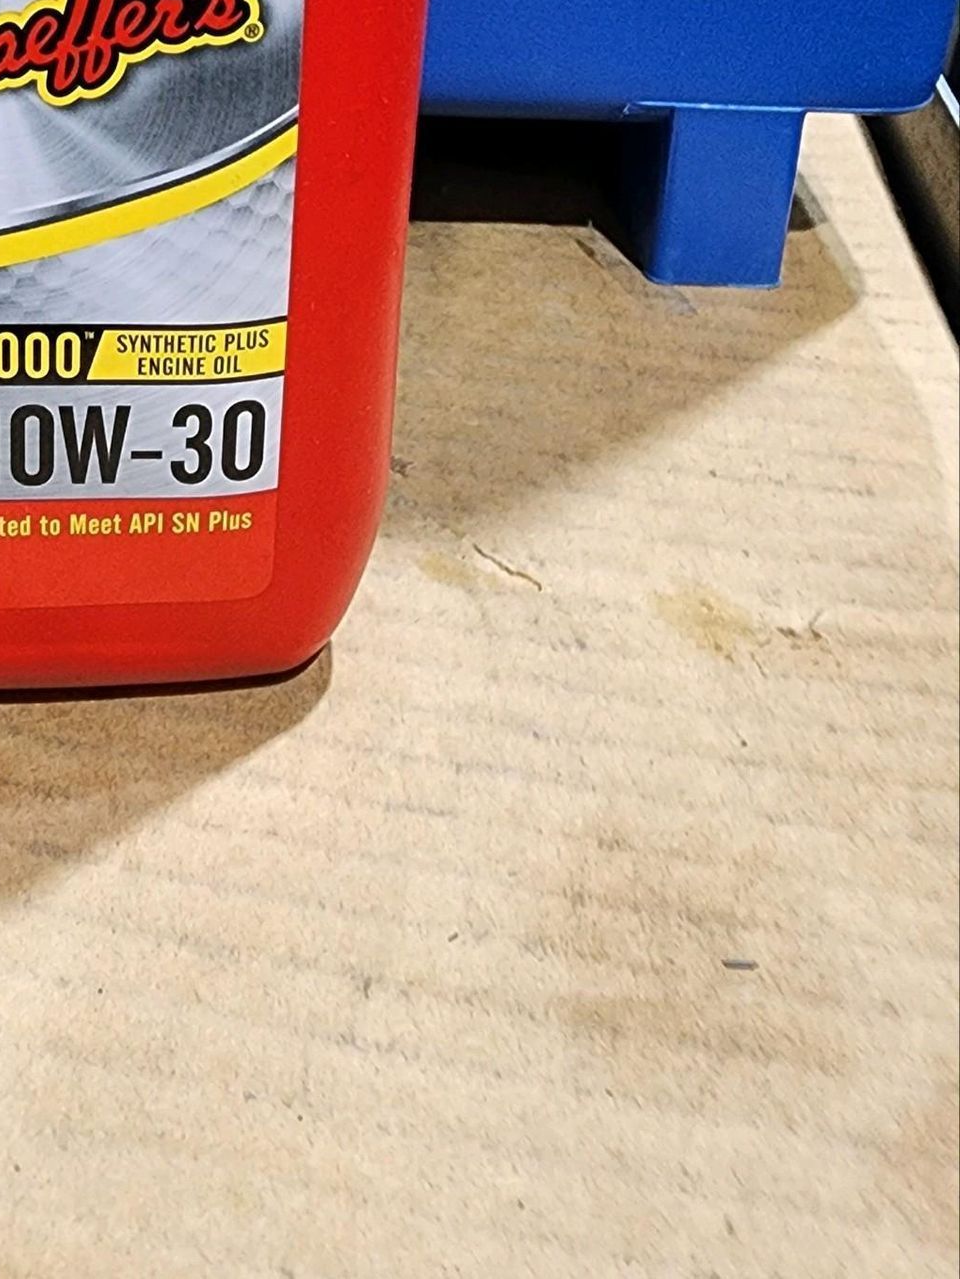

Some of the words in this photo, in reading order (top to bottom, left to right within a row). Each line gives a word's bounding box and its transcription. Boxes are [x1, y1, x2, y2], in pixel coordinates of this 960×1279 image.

[116, 333, 217, 354] SYNTHETIC
[223, 328, 270, 351] PLUS
[137, 356, 206, 376] ENGINE
[213, 354, 243, 375] OIL
[39, 517, 61, 537] to
[69, 513, 122, 536] Meet
[128, 512, 164, 535] API
[171, 511, 201, 534] SN
[208, 510, 253, 532] Plus
